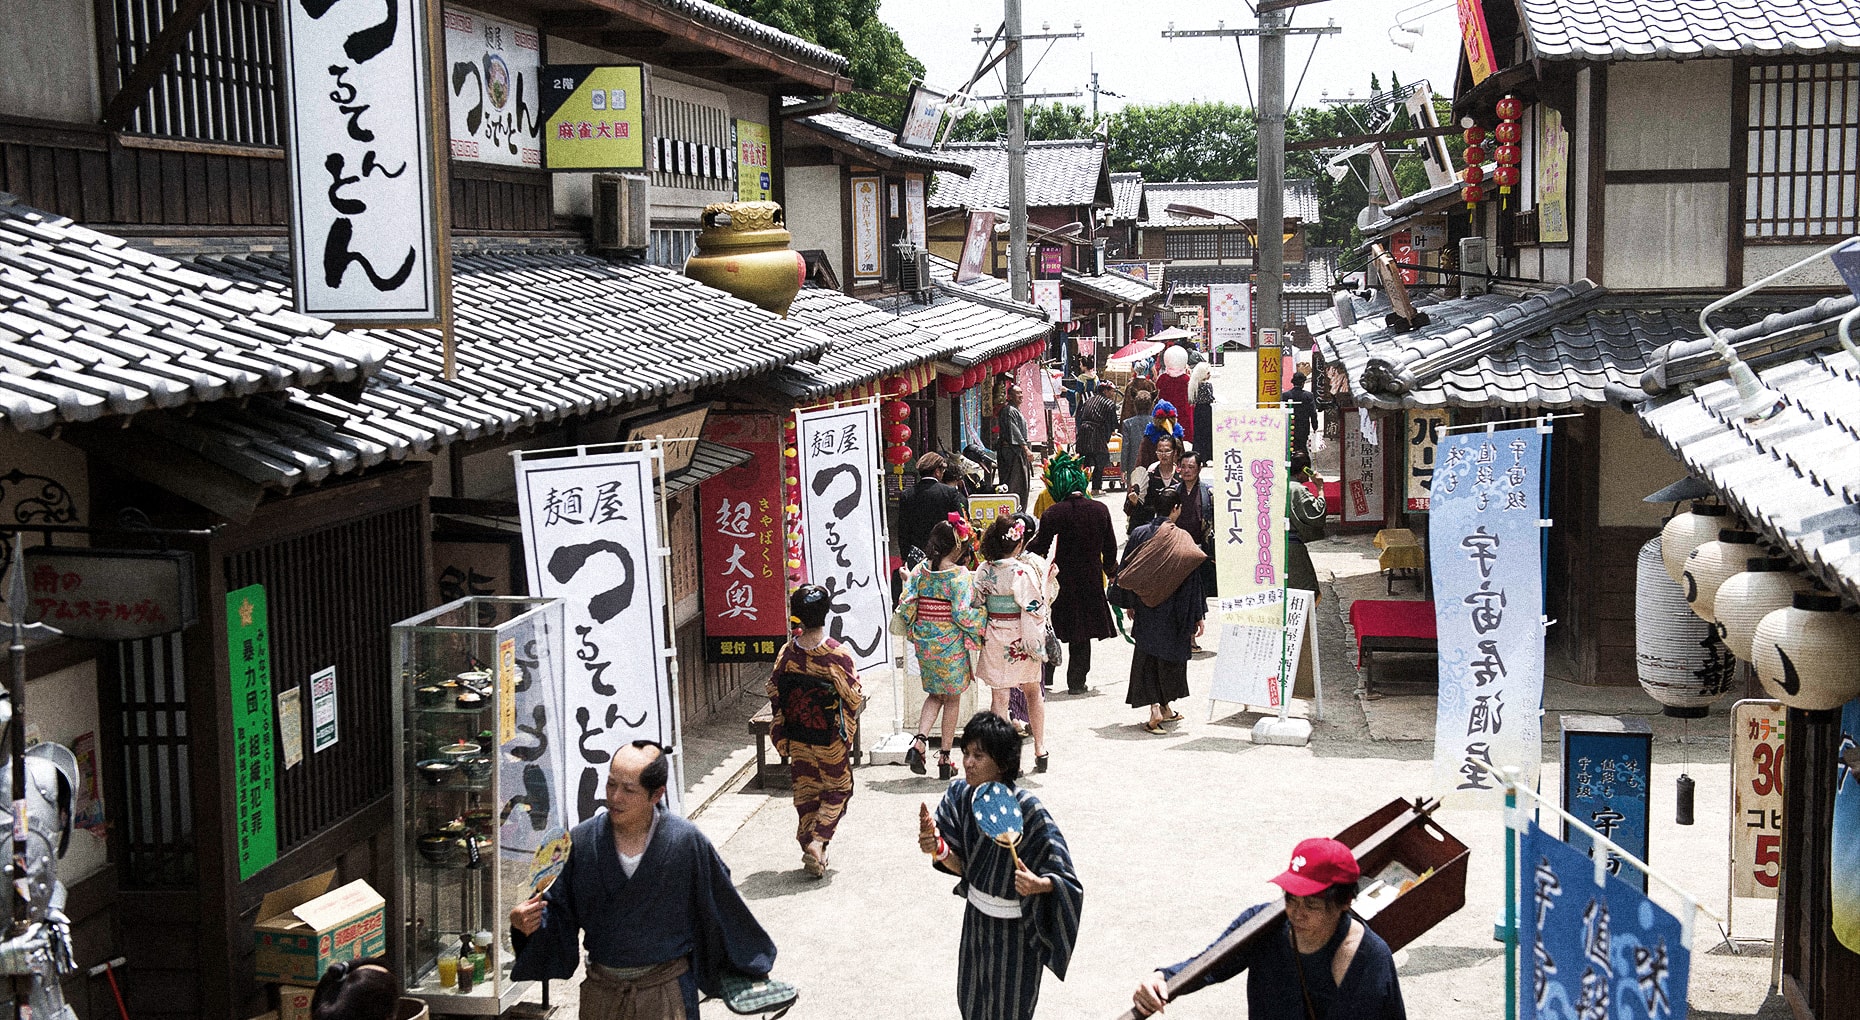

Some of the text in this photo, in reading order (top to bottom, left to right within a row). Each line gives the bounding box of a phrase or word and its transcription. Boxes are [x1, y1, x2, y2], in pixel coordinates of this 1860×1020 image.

[553, 78, 574, 90] 2階
[557, 121, 630, 140] 麻雀大國
[861, 263, 874, 271] 2階
[811, 423, 860, 459] 麺屋
[543, 480, 628, 527] 麺屋
[715, 497, 759, 621] 超大奥
[720, 641, 774, 655] 受付 1階
